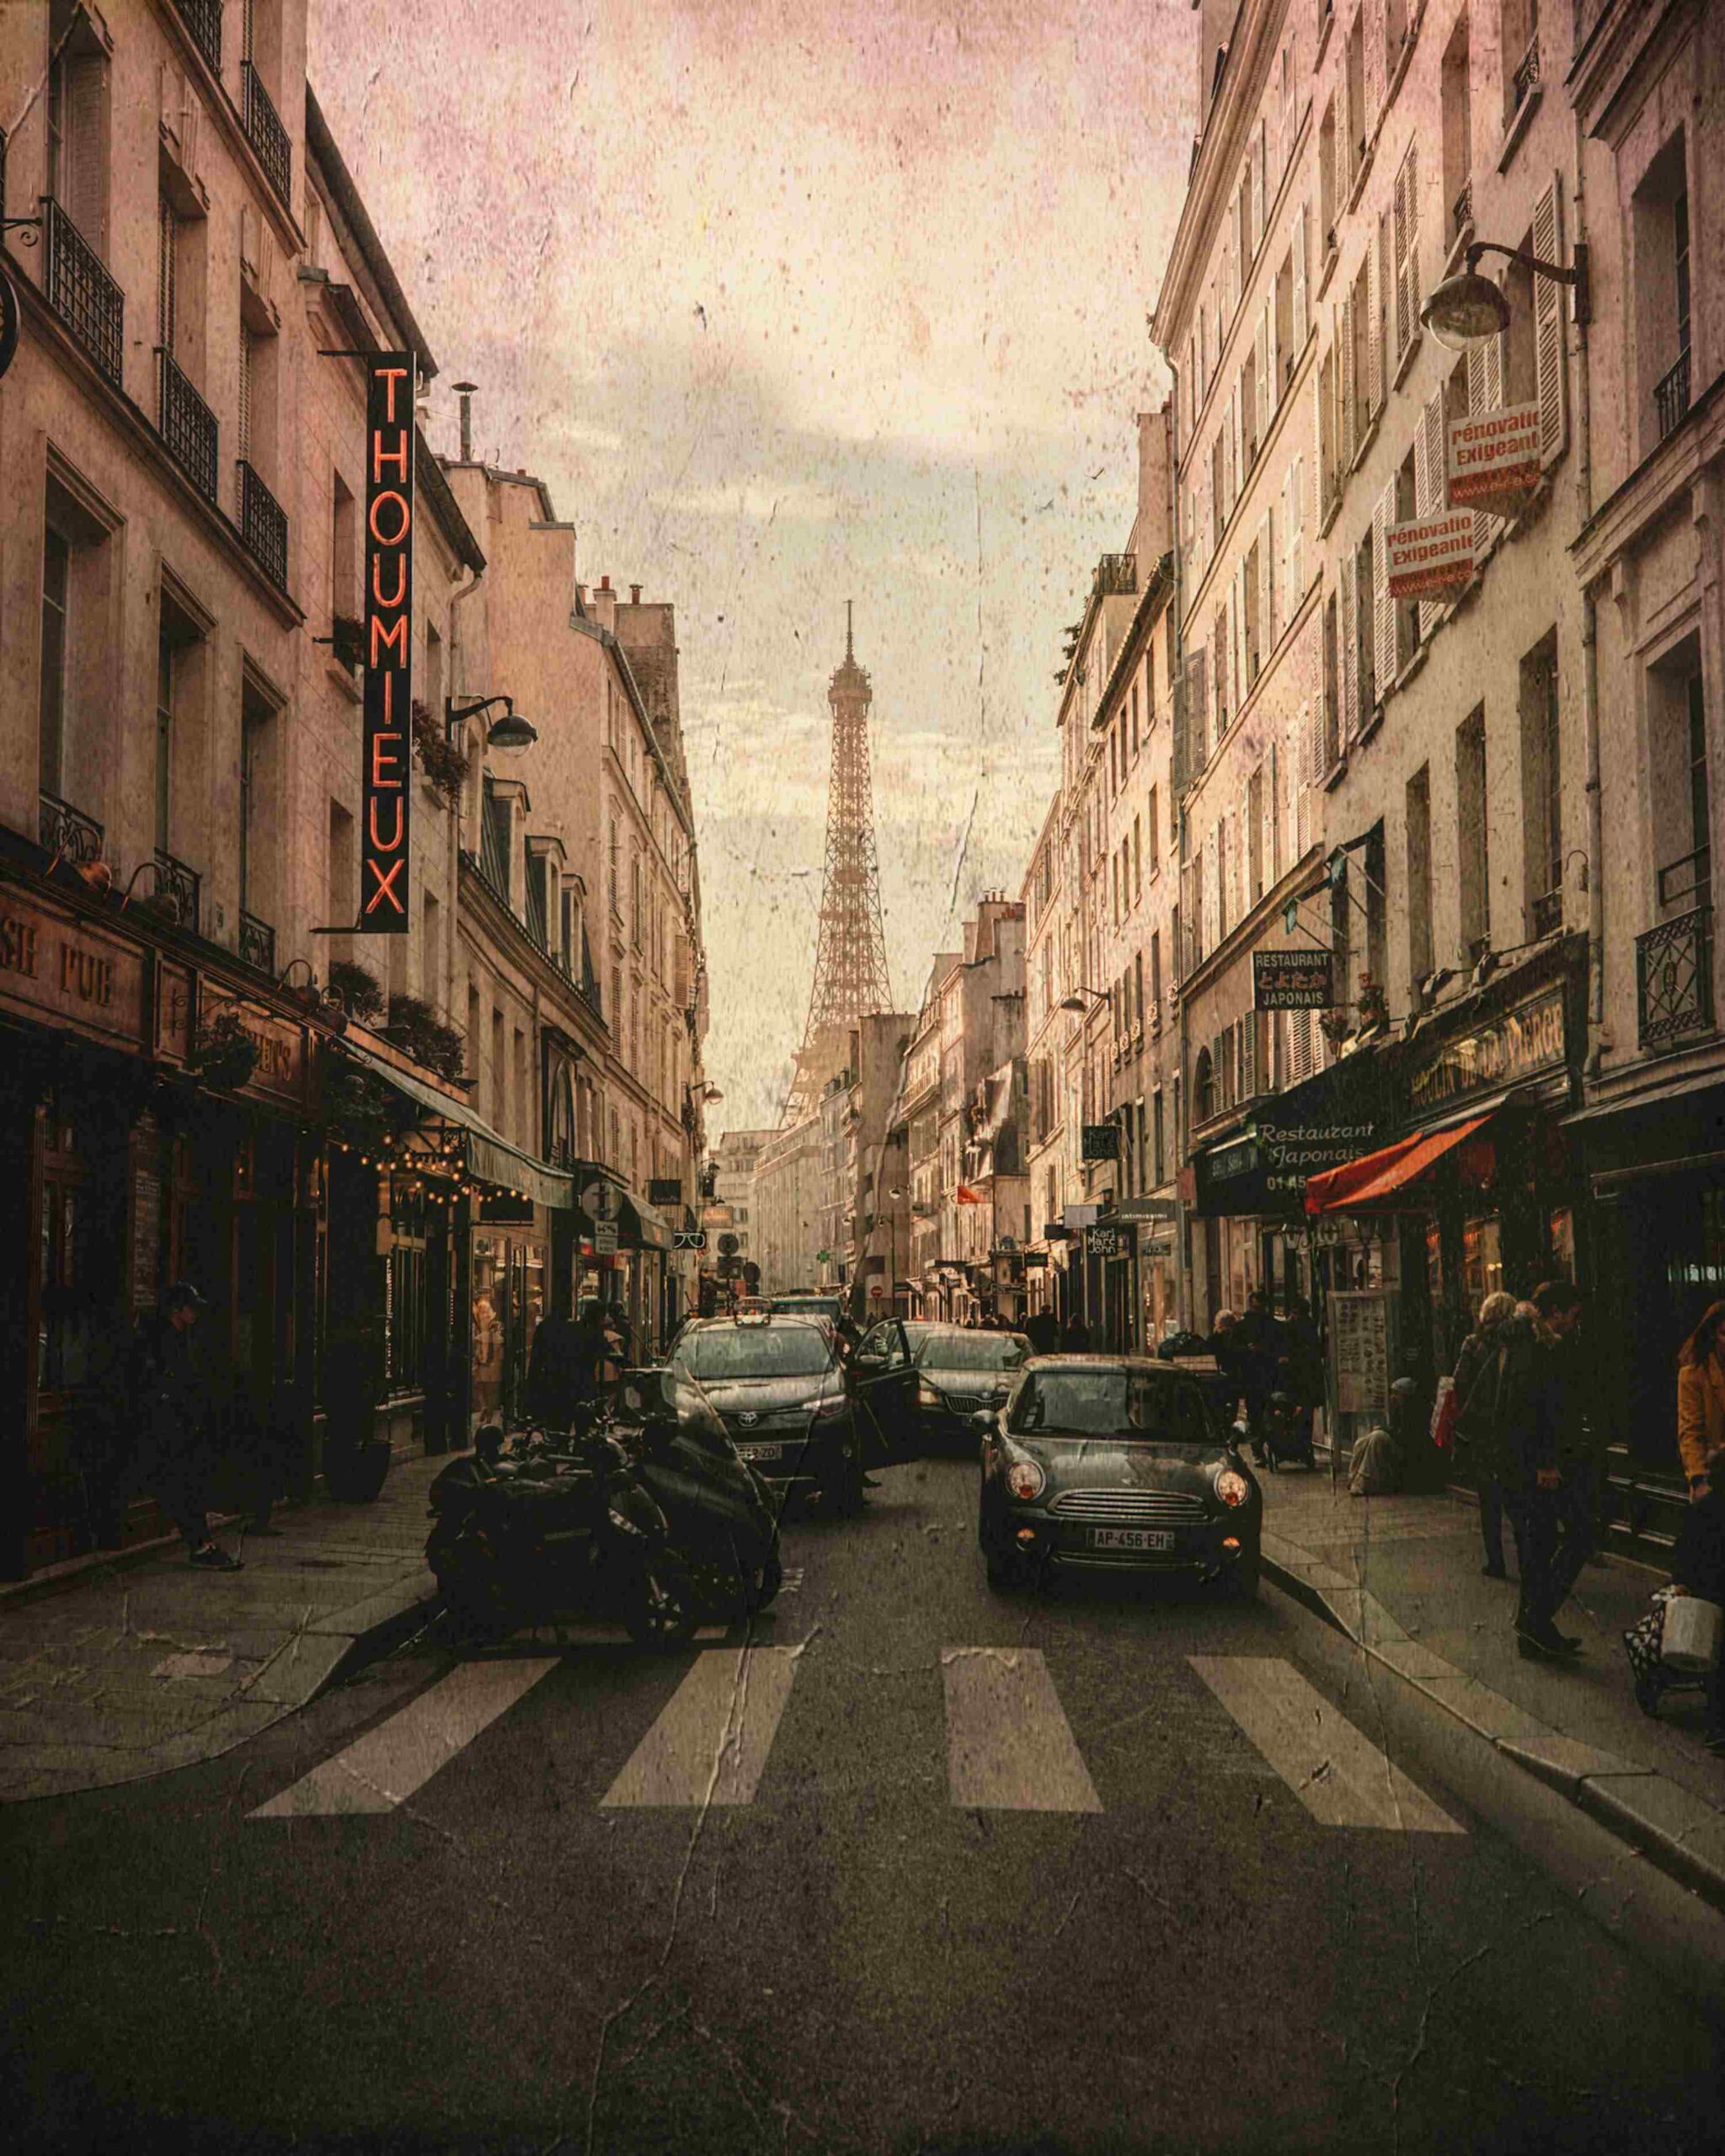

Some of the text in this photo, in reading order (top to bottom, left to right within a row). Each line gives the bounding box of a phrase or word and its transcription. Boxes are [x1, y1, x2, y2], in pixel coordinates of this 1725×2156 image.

[366, 368, 410, 914] THOUMIEUX
[1256, 953, 1328, 968] RESTAURANT
[60, 942, 113, 1007] PUB
[1263, 992, 1323, 1006] JAPONAIS
[1259, 1121, 1375, 1143] Restaurant
[1273, 1145, 1365, 1169] Japonais
[1087, 1235, 1116, 1246] Marc
[1092, 1227, 1115, 1238] Karl
[1088, 1244, 1116, 1254] John
[1097, 1530, 1165, 1548] AP-456-EH
